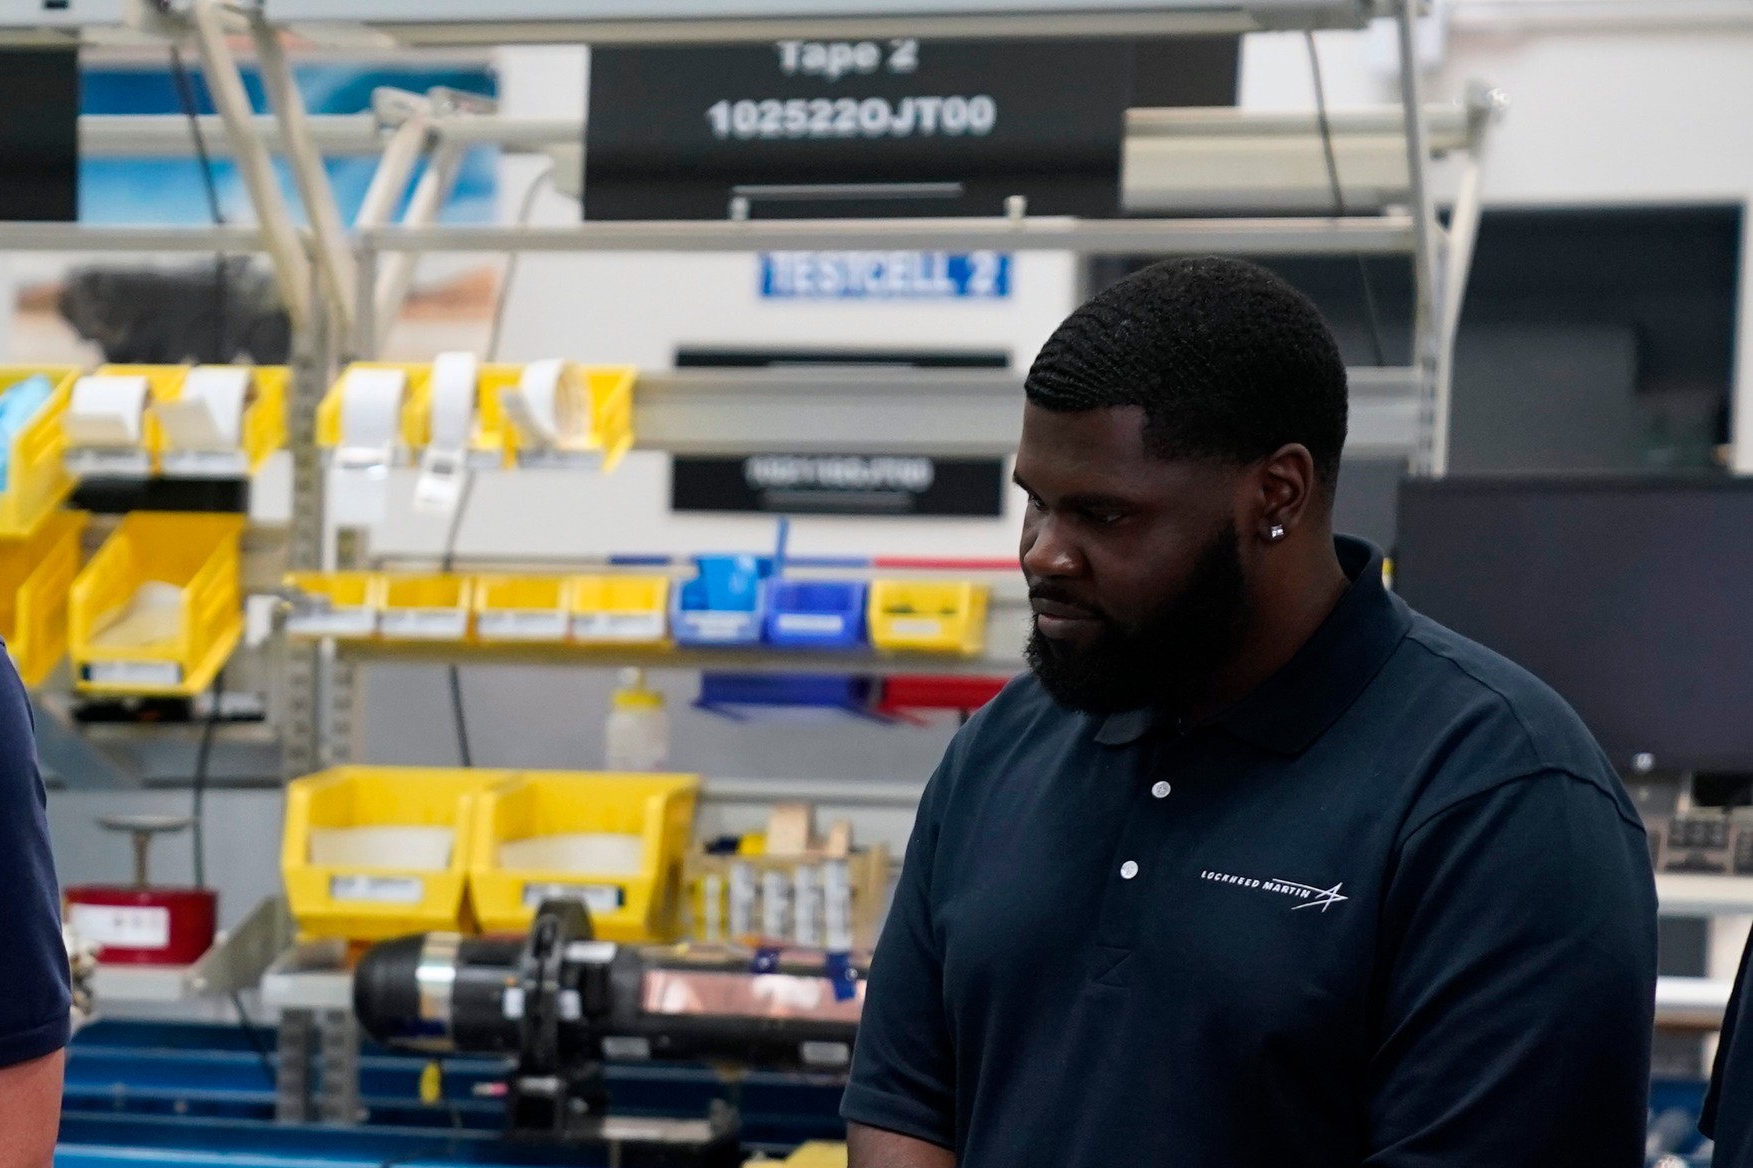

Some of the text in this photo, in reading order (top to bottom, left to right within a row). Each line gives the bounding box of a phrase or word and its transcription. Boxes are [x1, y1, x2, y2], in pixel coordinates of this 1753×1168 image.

[777, 39, 917, 81] Tape 2
[969, 251, 995, 294] 2
[1201, 870, 1312, 899] LOCKHEED MARTIN
